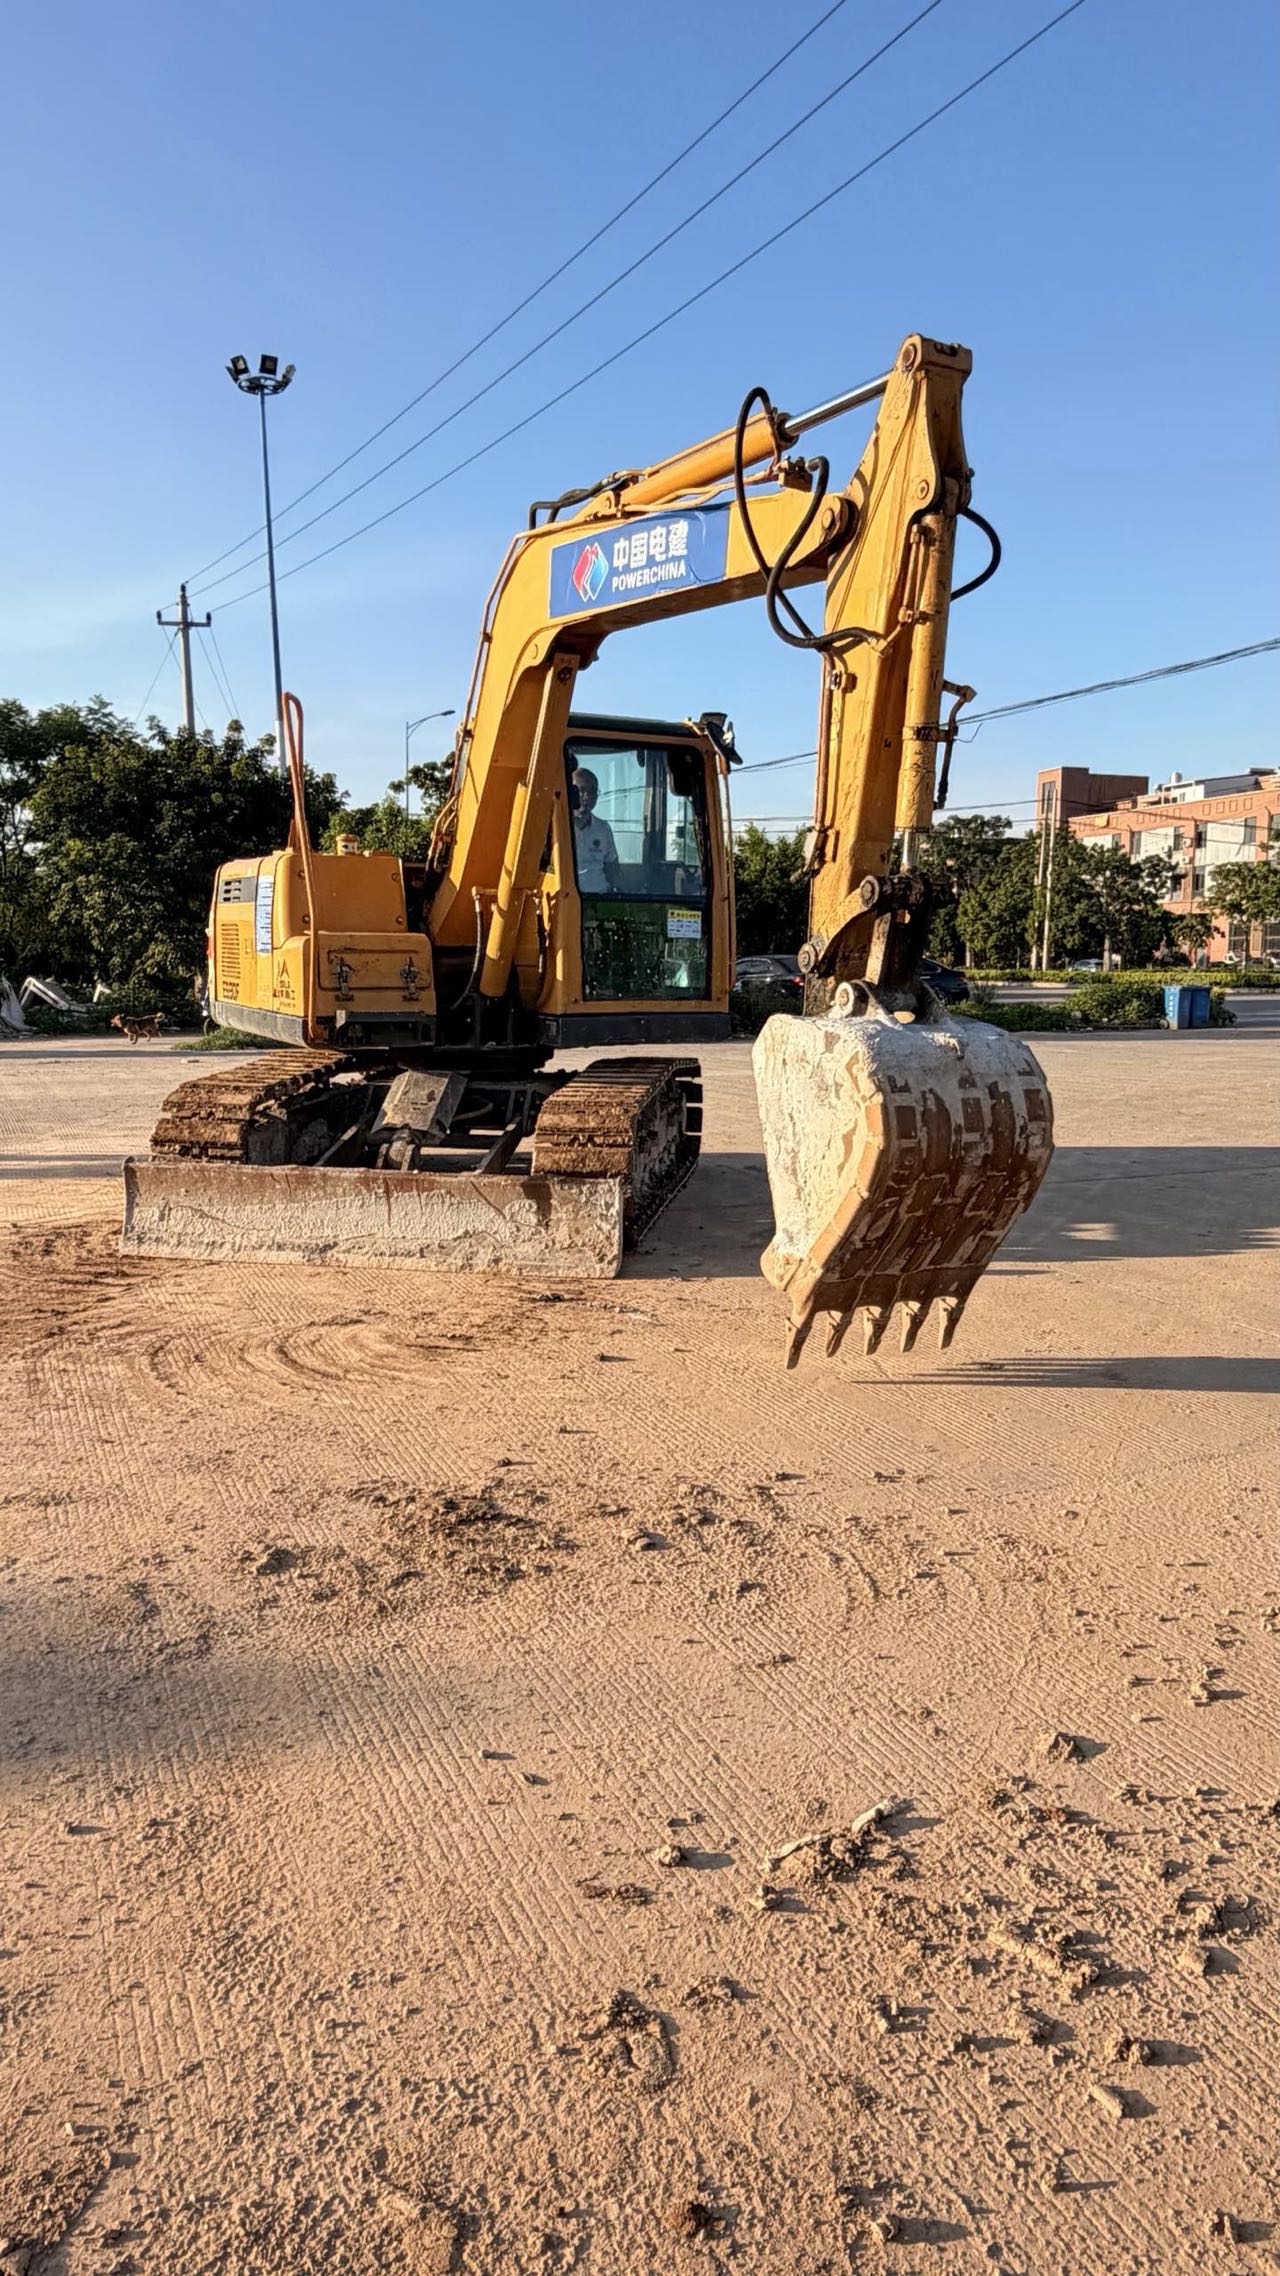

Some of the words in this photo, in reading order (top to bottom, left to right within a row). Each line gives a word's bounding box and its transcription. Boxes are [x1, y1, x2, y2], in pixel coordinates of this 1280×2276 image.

[613, 520, 688, 571] 中国电建
[612, 560, 686, 592] POWERCHINA
